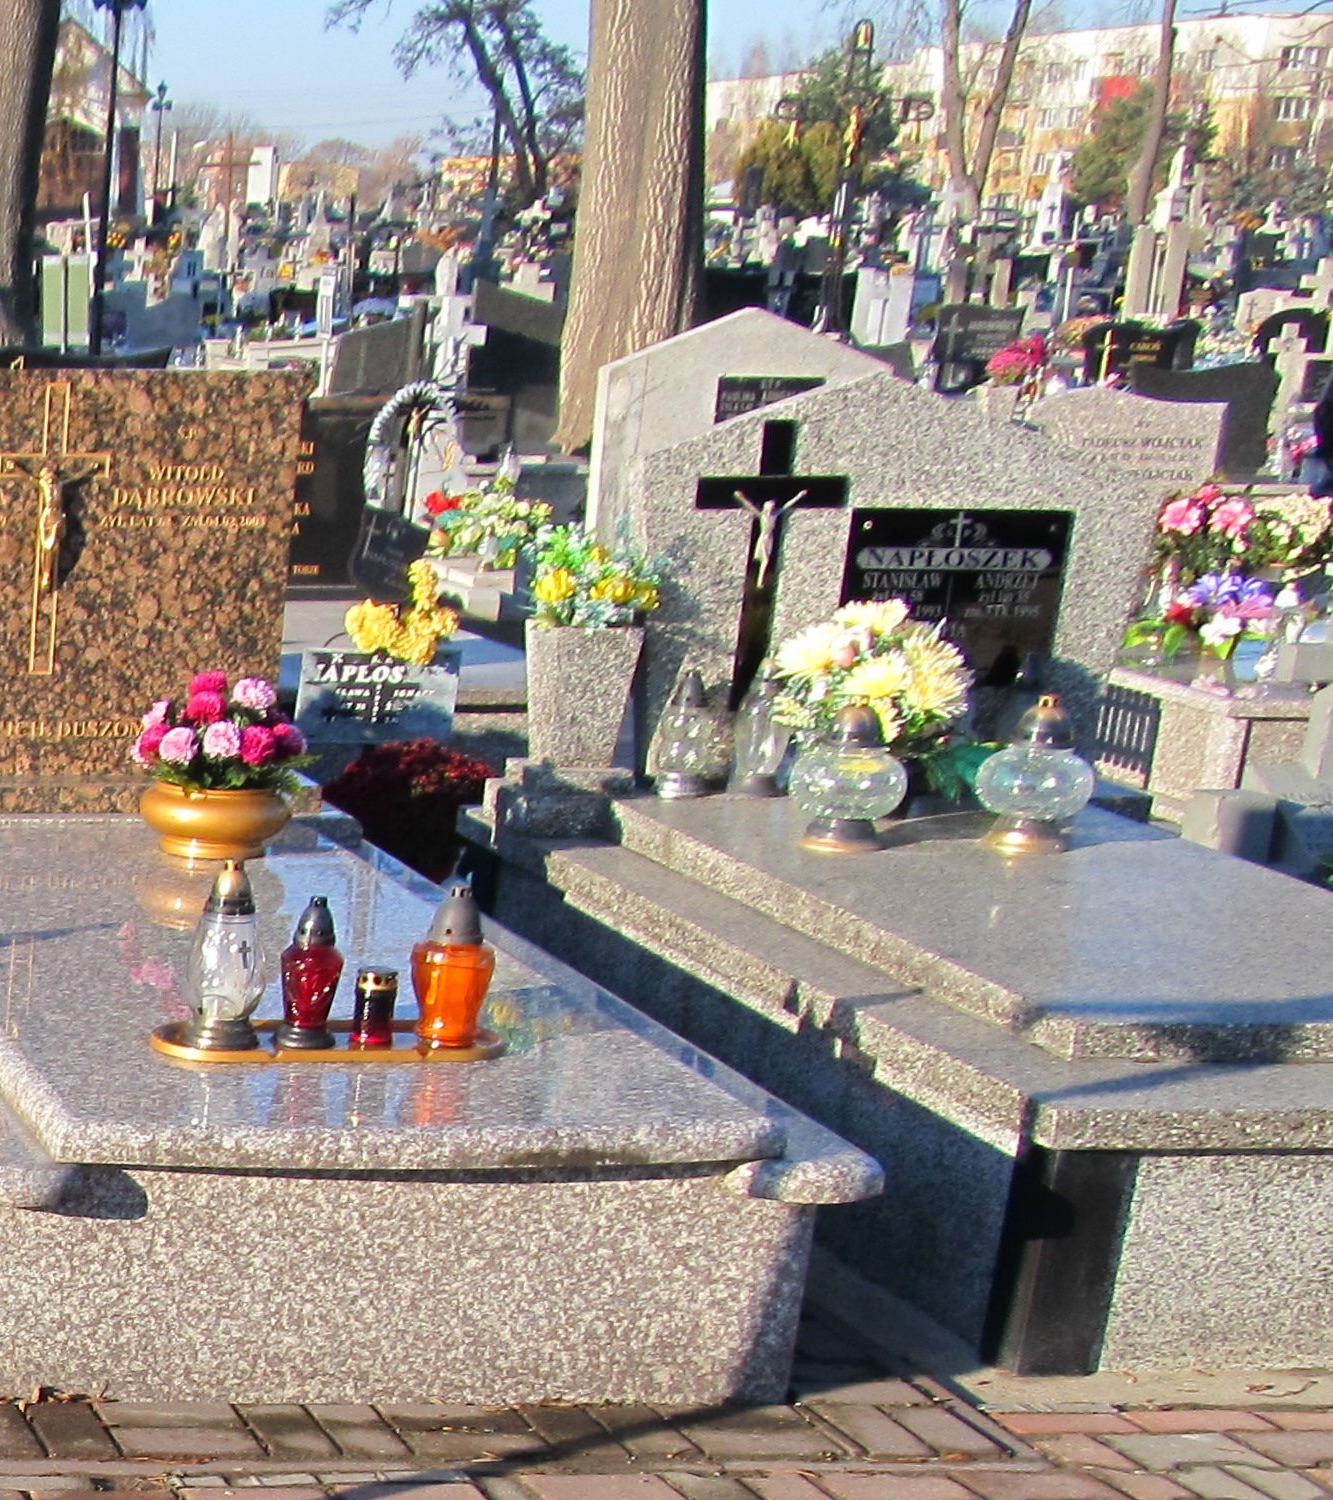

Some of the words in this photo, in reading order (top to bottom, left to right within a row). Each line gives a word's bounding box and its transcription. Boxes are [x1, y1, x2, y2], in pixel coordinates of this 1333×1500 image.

[149, 466, 225, 481] WITOLD
[113, 487, 256, 510] DĄBROWSKI
[865, 549, 1041, 568] NAPŁOSZEK
[863, 572, 943, 589] STANISŁAW
[975, 572, 1040, 590] ANDRZEJ
